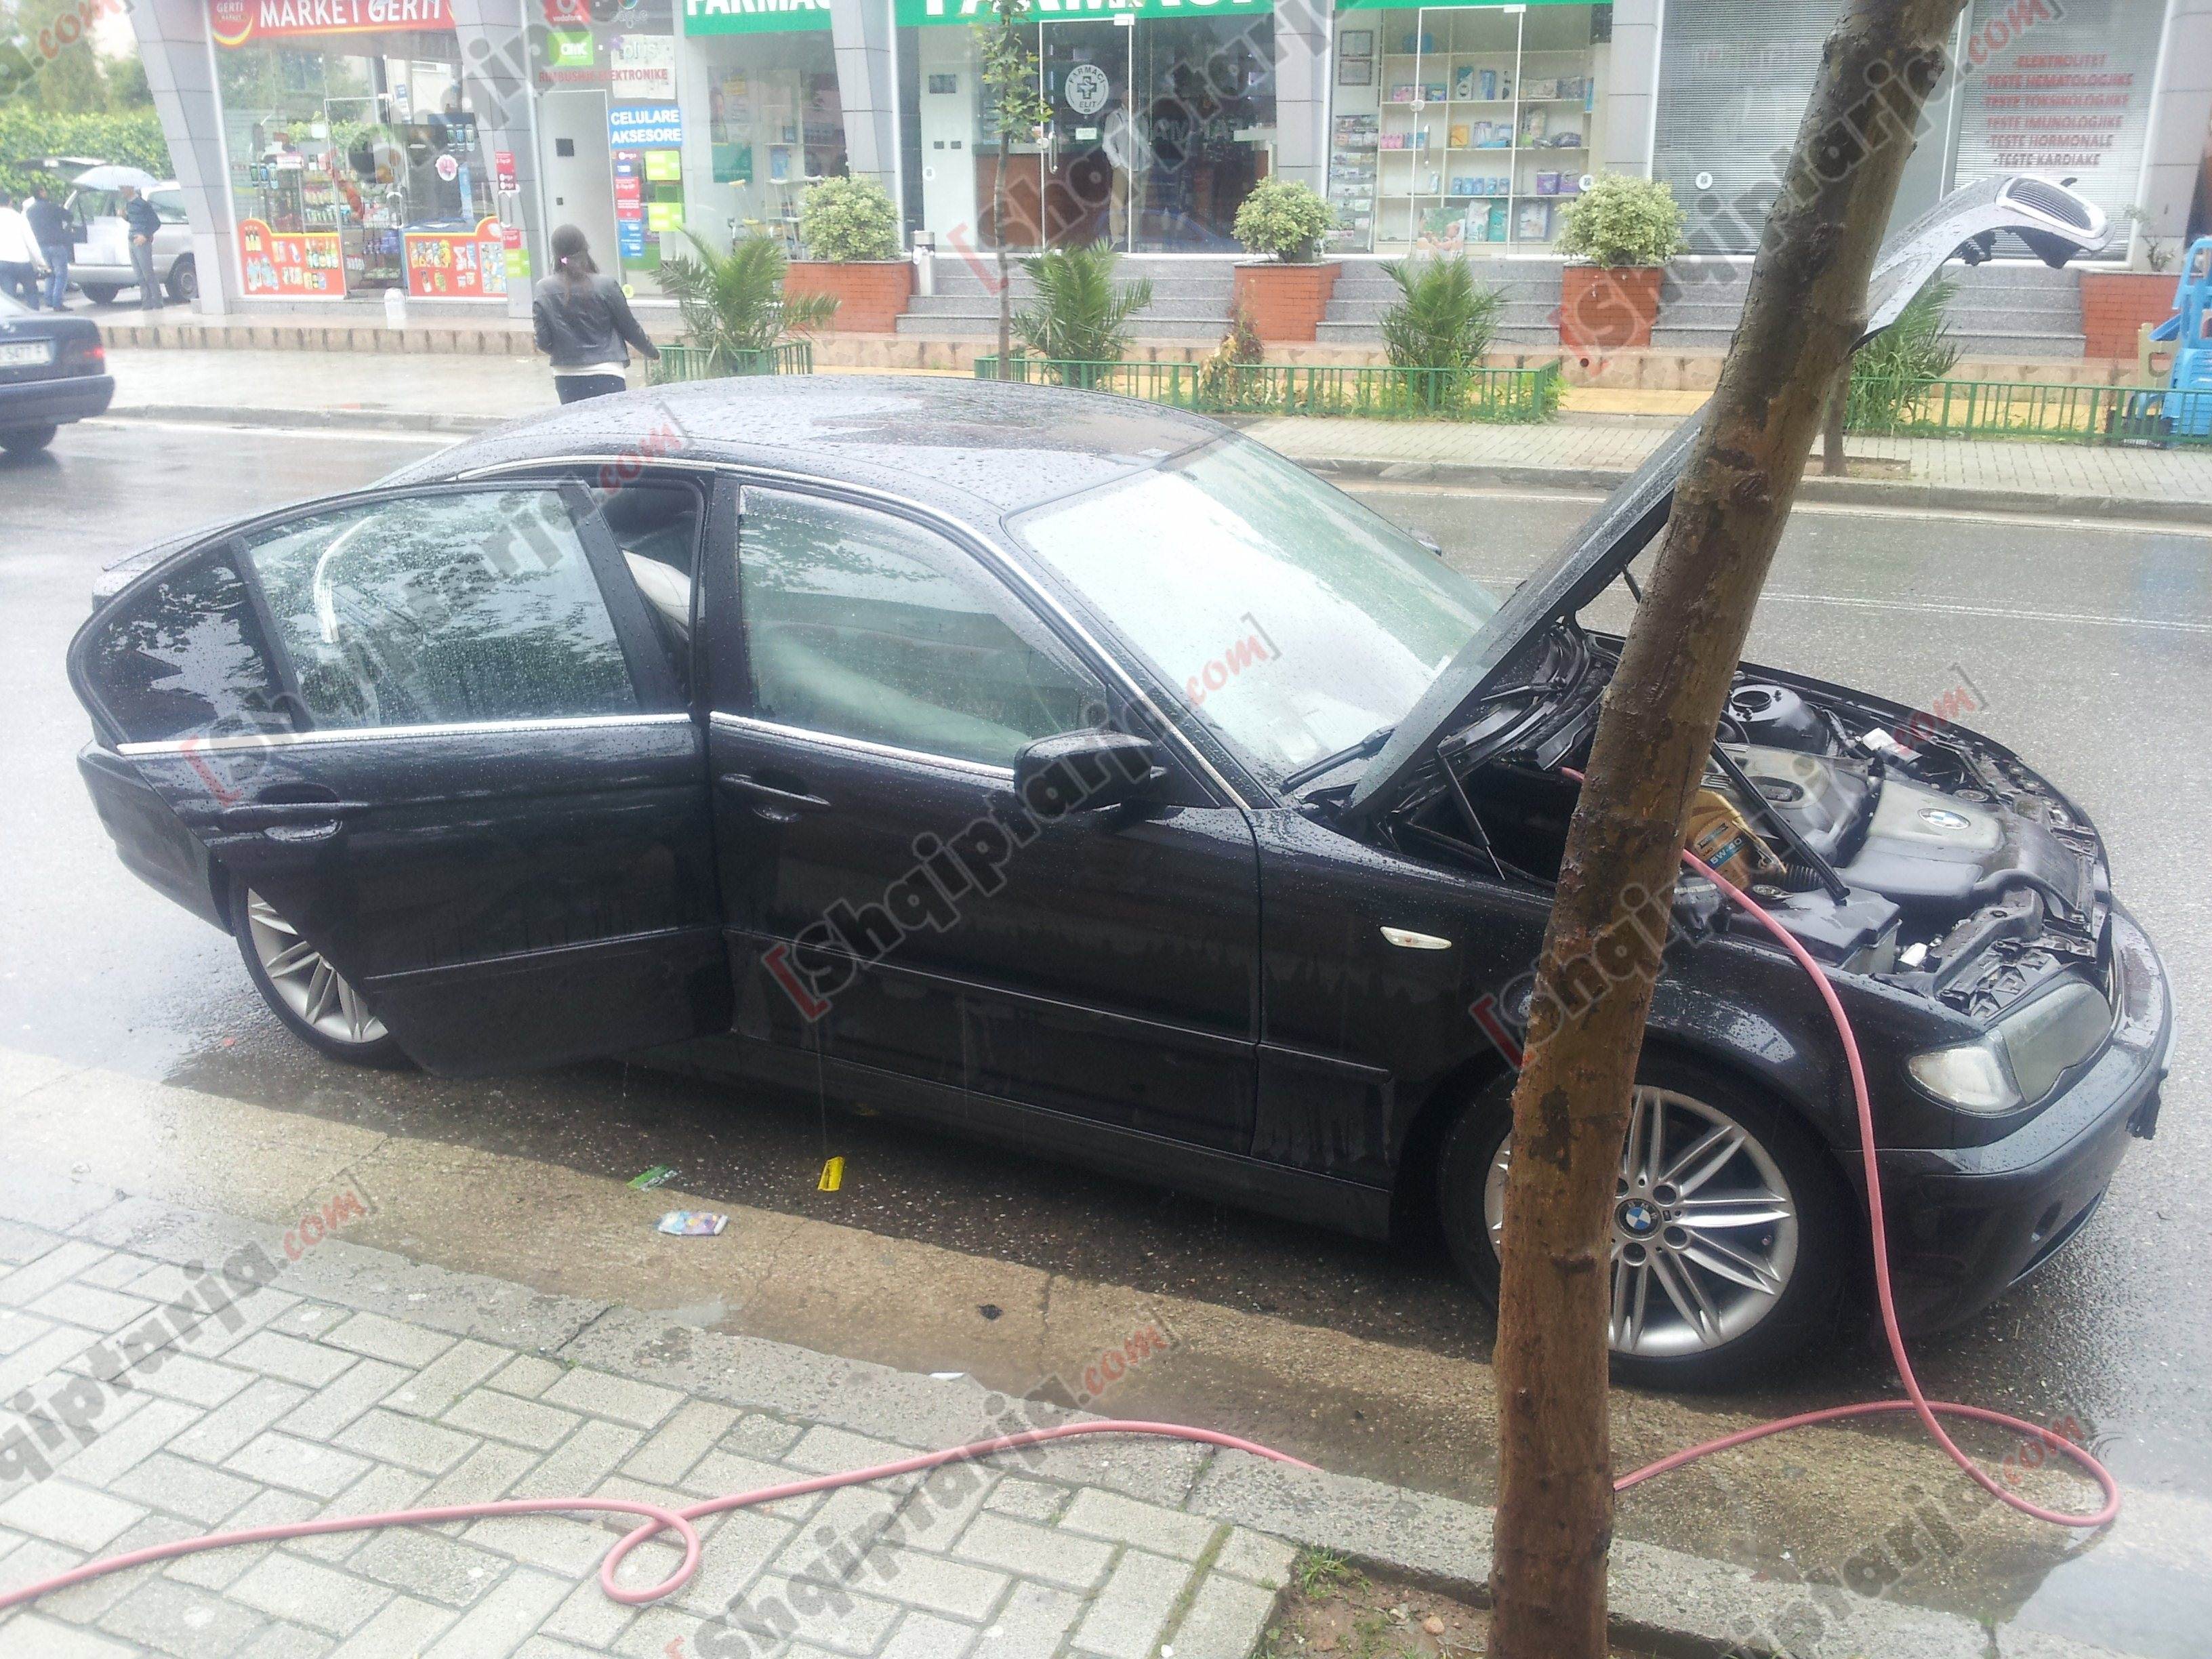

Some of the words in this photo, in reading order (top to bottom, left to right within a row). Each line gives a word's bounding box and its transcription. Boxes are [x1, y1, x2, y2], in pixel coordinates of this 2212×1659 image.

[260, 0, 361, 28] MARKET
[367, 0, 441, 22] GERTI
[611, 109, 680, 125] CELULARE
[611, 128, 682, 144] AKSESORE
[2036, 153, 2101, 165] KARDIAKE
